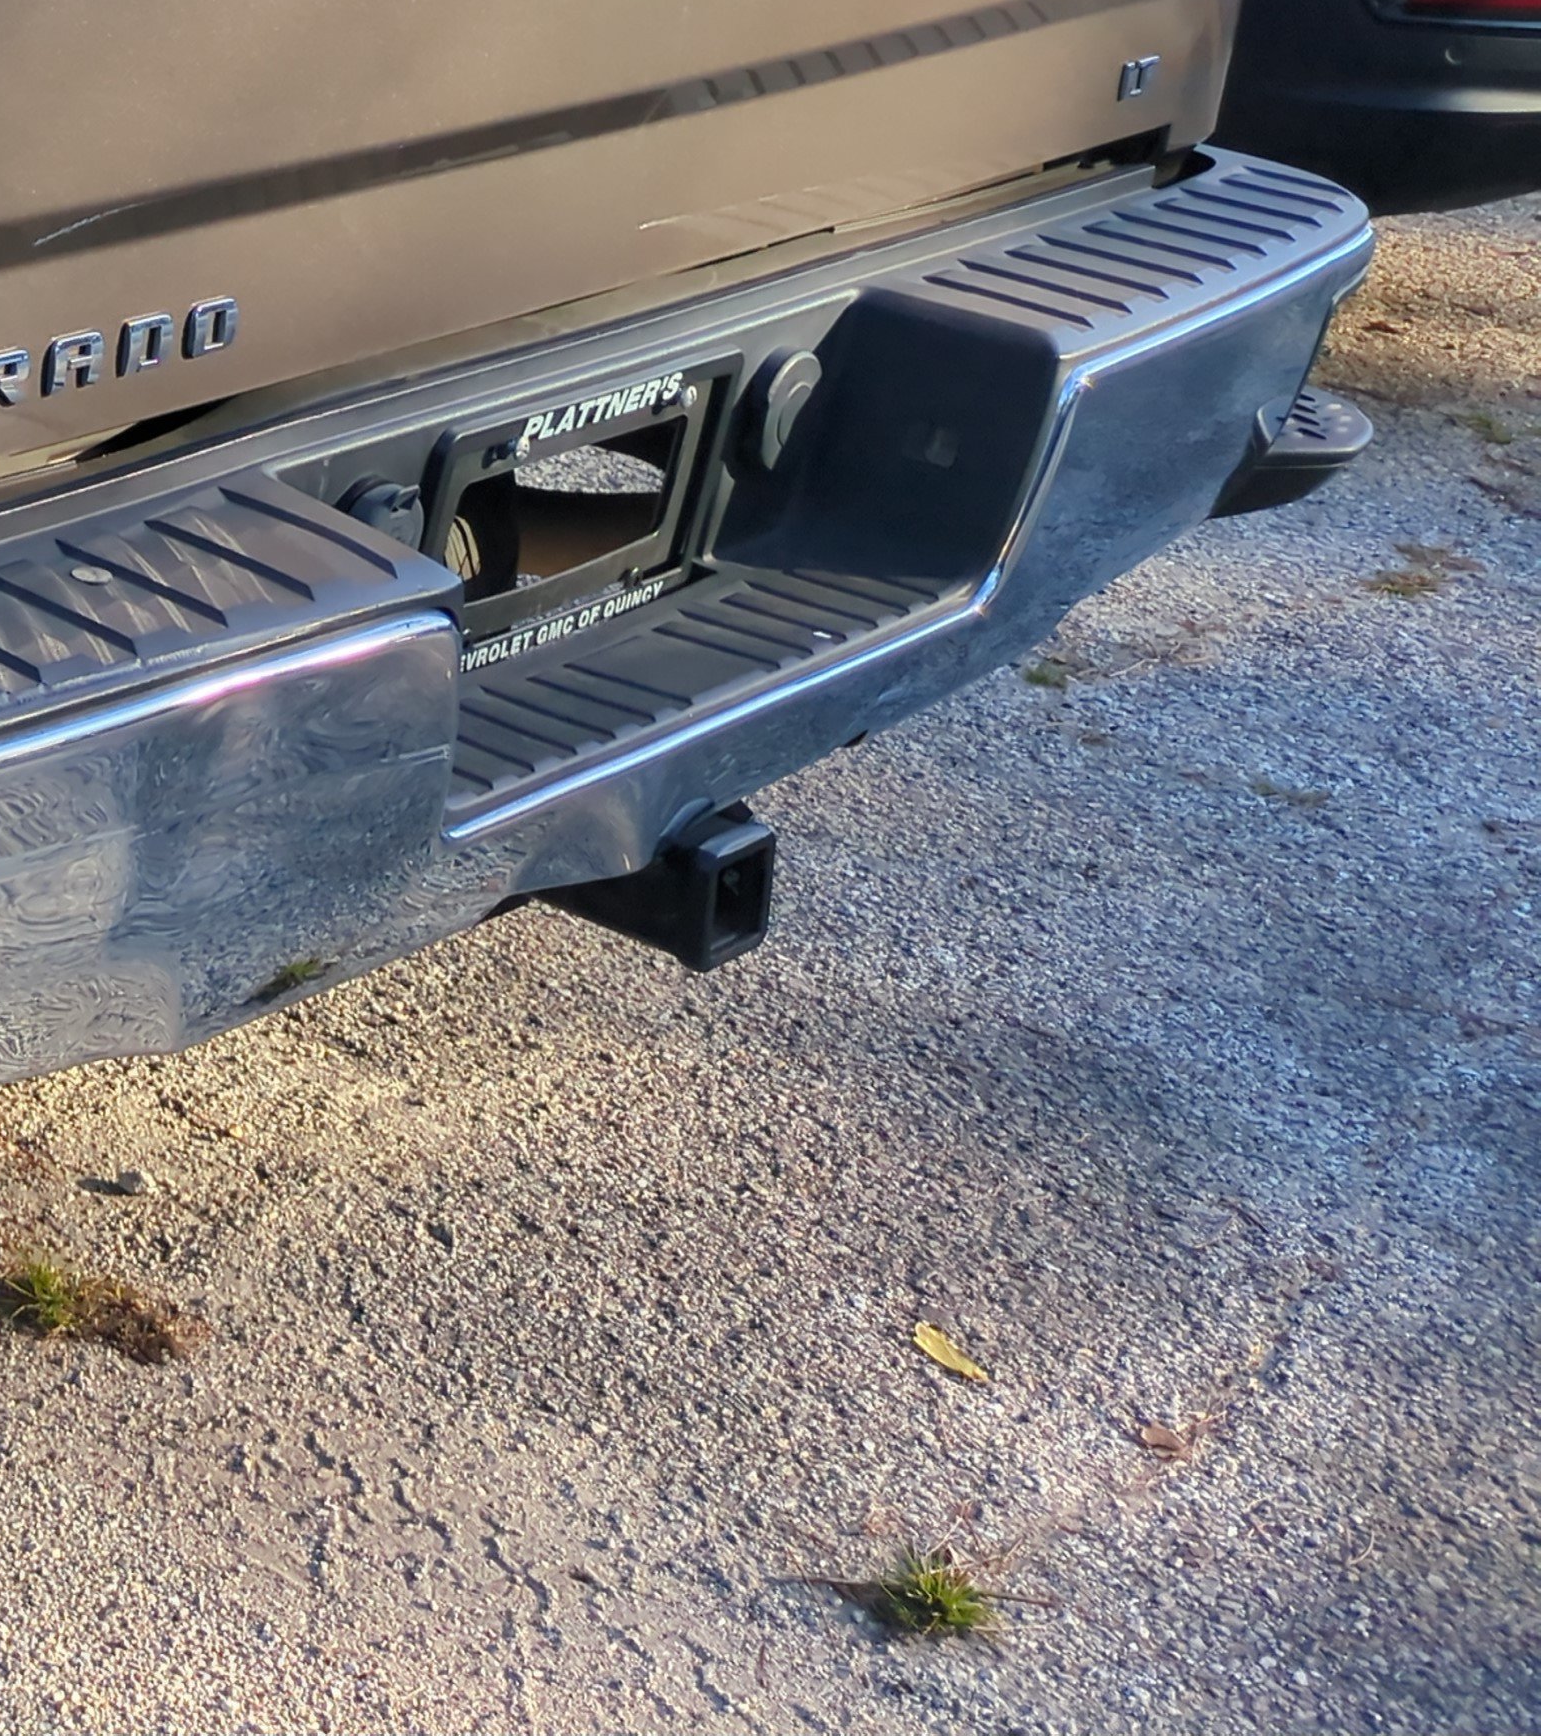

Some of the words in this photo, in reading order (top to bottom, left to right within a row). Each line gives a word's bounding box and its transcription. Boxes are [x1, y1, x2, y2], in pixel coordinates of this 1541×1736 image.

[522, 371, 684, 441] PLATTNER'S
[536, 614, 577, 646] GMC
[577, 606, 603, 629] OF
[603, 580, 665, 619] QUINCY
